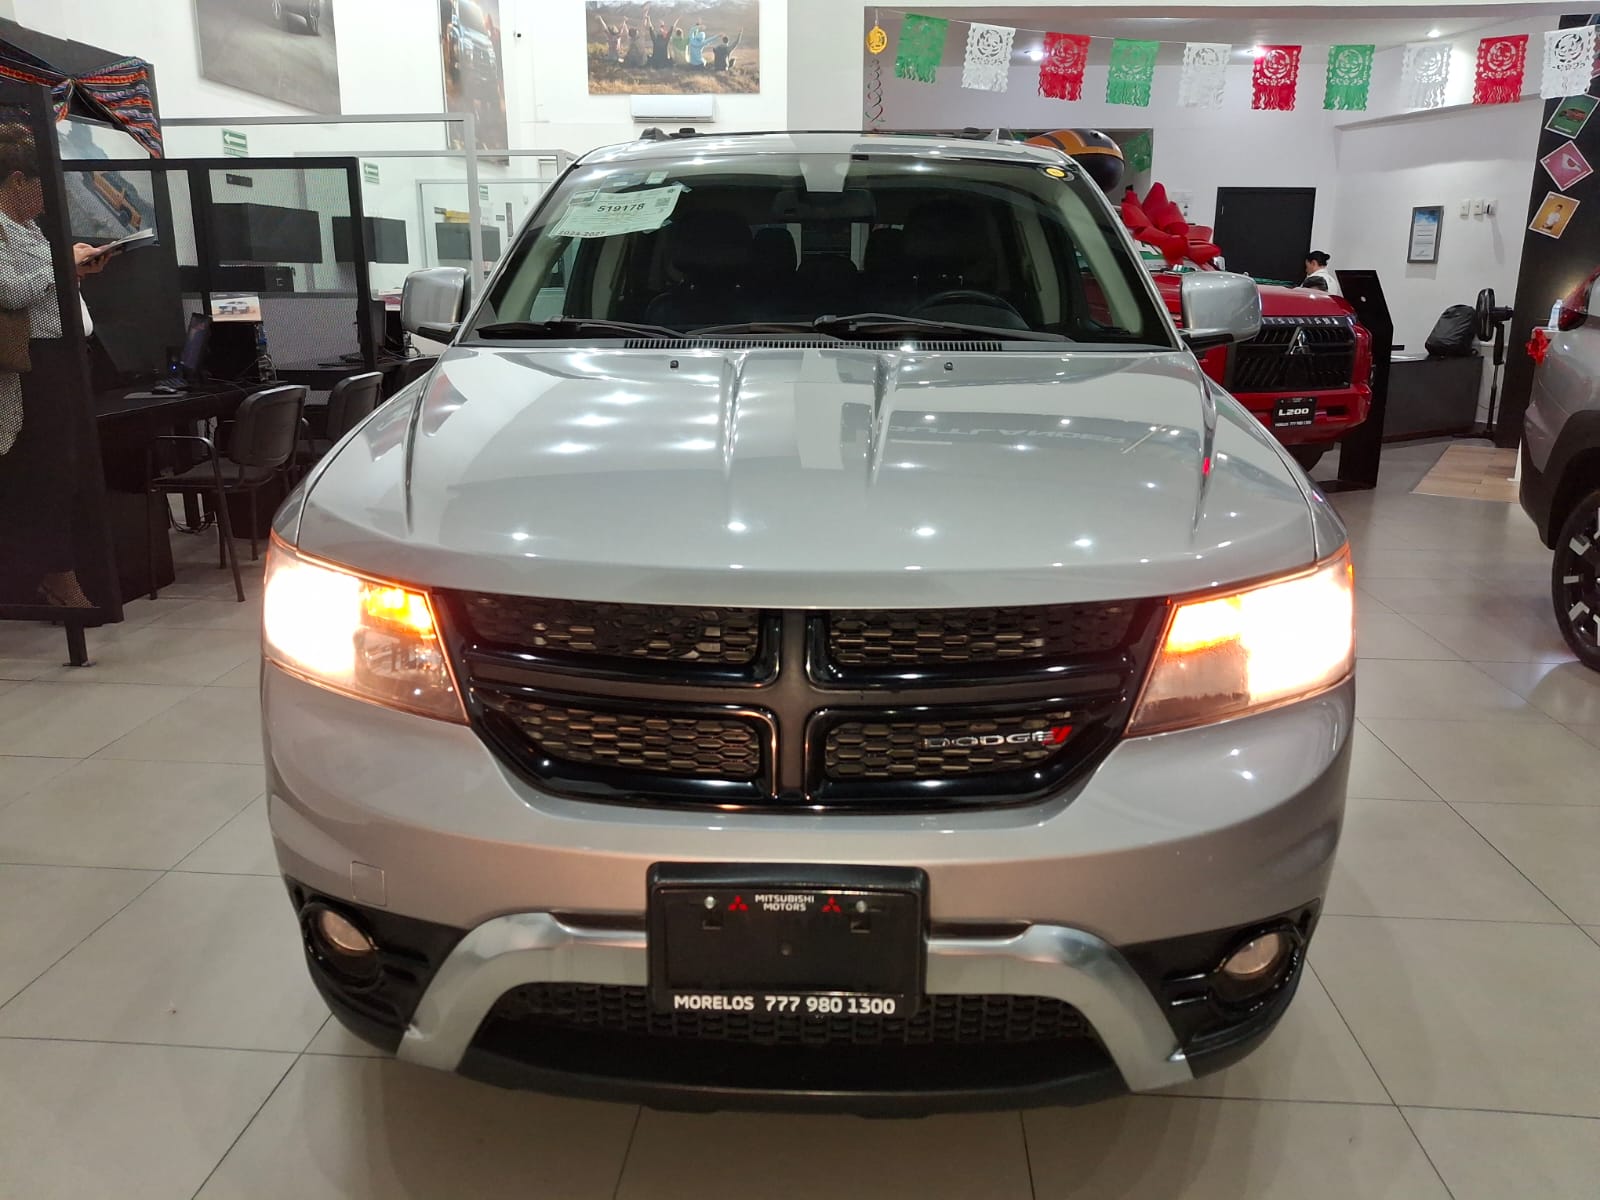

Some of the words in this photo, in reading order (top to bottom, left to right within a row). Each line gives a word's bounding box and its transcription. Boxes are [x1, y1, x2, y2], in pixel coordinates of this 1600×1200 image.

[597, 203, 645, 213] 519178
[1278, 407, 1310, 417] L200
[924, 731, 1053, 748] DODGE
[754, 894, 815, 903] MITSUBISHI
[763, 902, 807, 912] MOTORS
[673, 995, 755, 1011] MORELOS
[764, 996, 801, 1012] 777
[806, 996, 843, 1013] 980
[847, 998, 896, 1014] 1300
